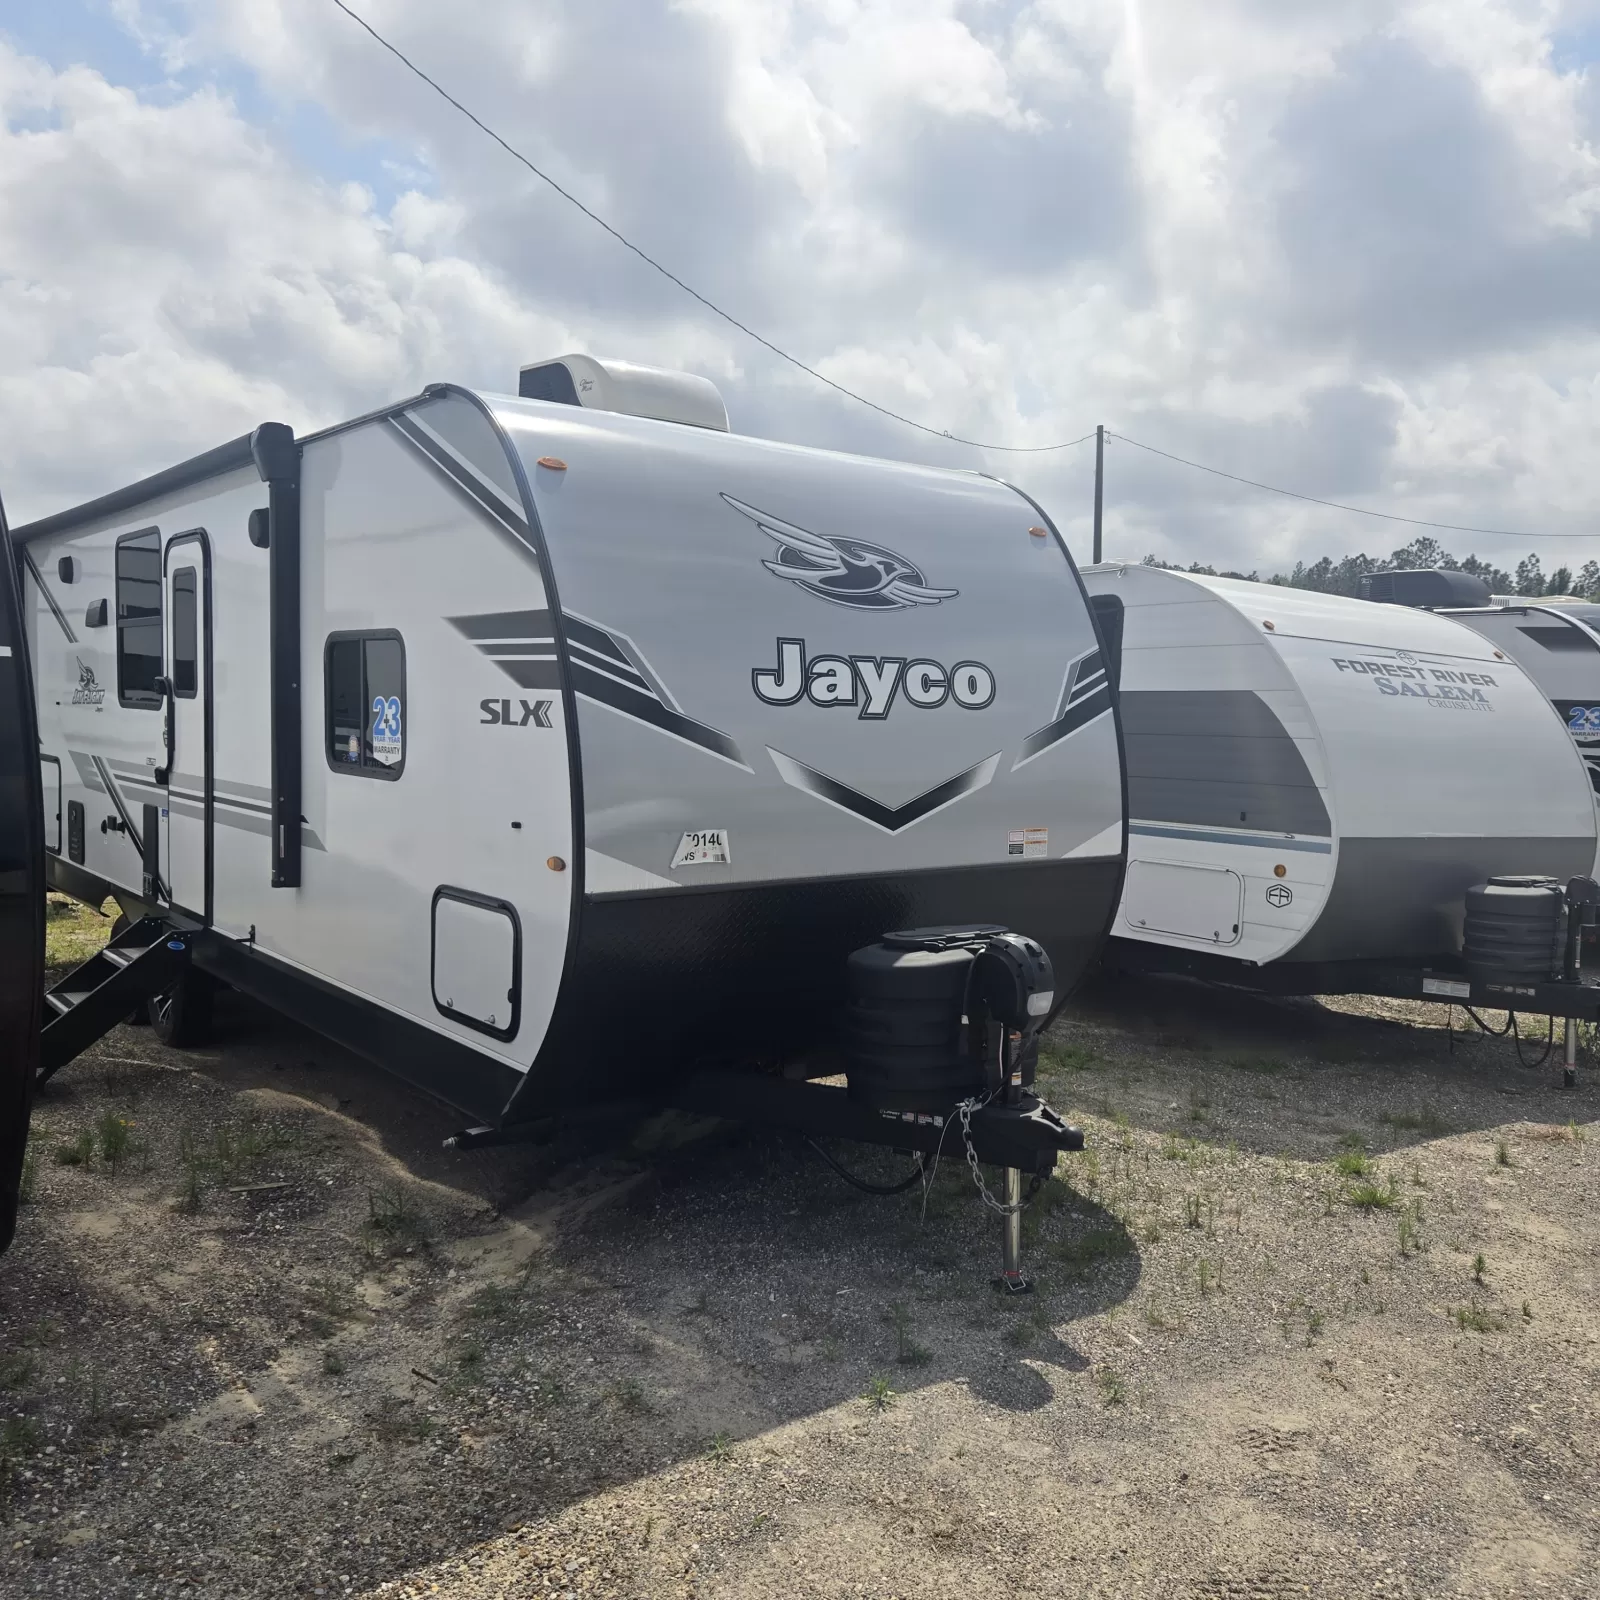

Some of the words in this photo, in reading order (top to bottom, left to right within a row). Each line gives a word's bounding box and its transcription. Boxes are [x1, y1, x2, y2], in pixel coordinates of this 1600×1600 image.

[751, 637, 996, 720] Jayco
[1330, 658, 1427, 680] FOREST
[1428, 669, 1499, 687] RIVER
[1373, 677, 1489, 703] SALEM
[480, 699, 553, 728] SLX
[373, 746, 400, 754] WARRANTY
